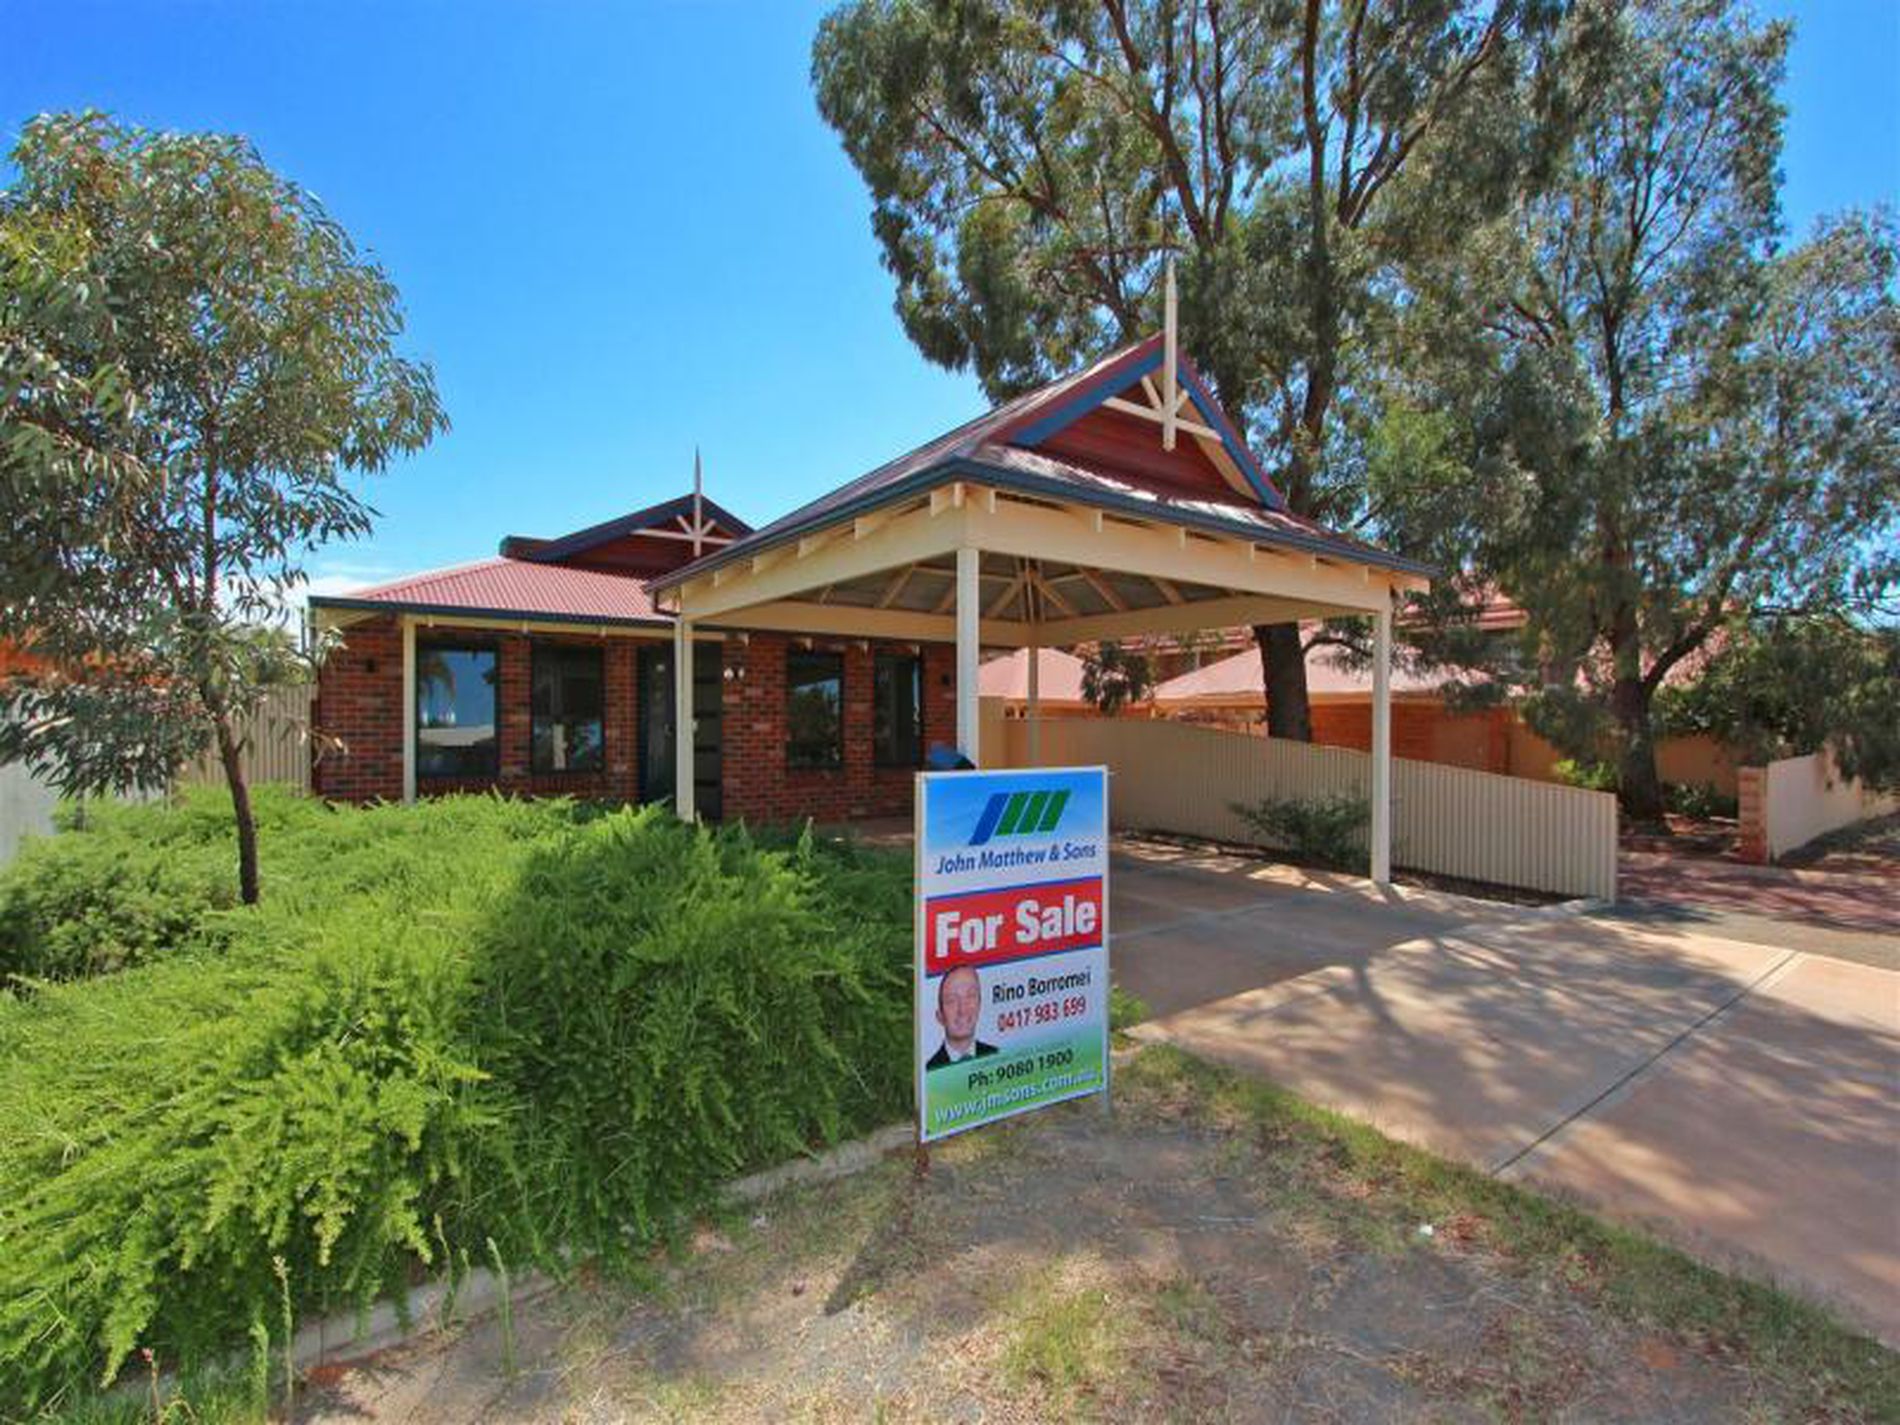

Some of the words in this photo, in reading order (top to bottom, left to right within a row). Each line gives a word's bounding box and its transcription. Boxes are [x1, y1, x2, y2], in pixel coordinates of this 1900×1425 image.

[937, 854, 975, 874] John
[979, 847, 1045, 870] Matthew
[1049, 845, 1059, 861] &
[1064, 842, 1097, 861] Sons
[936, 911, 1004, 958] For
[1016, 896, 1096, 943] Sale
[992, 982, 1025, 1004] Rino
[1028, 966, 1091, 996] Borromei
[998, 1007, 1031, 1032] 0417
[968, 1071, 994, 1090] Ph:
[997, 1059, 1034, 1081] 9080
[1039, 1048, 1073, 1070] 1900
